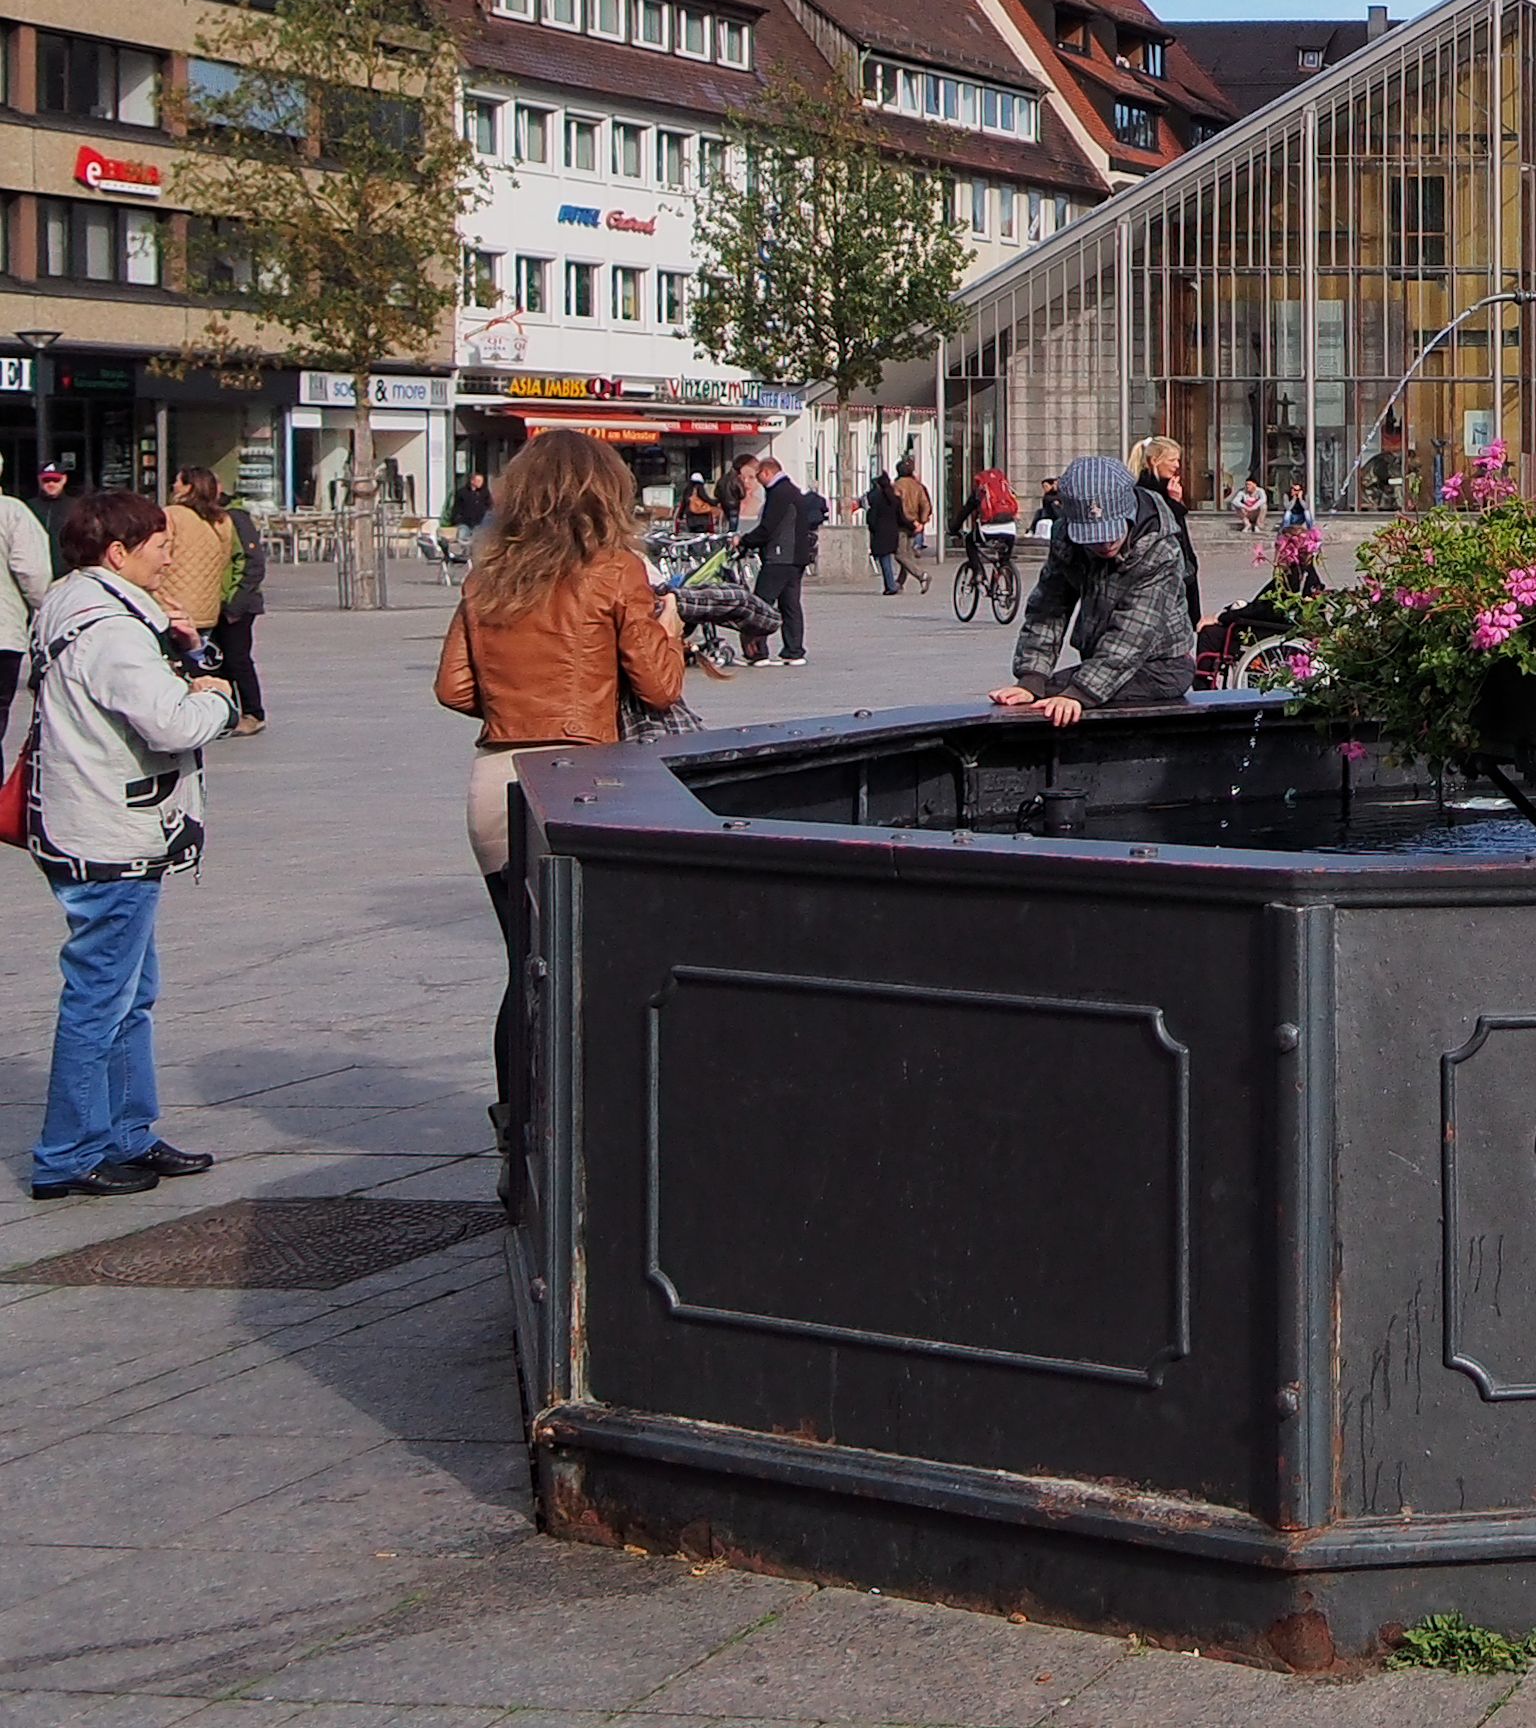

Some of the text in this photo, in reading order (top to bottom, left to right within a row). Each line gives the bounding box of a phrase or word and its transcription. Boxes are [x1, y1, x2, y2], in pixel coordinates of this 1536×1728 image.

[375, 378, 388, 402] &
[392, 383, 426, 400] more
[509, 377, 542, 397] ASIA
[543, 378, 588, 398] IMBISS
